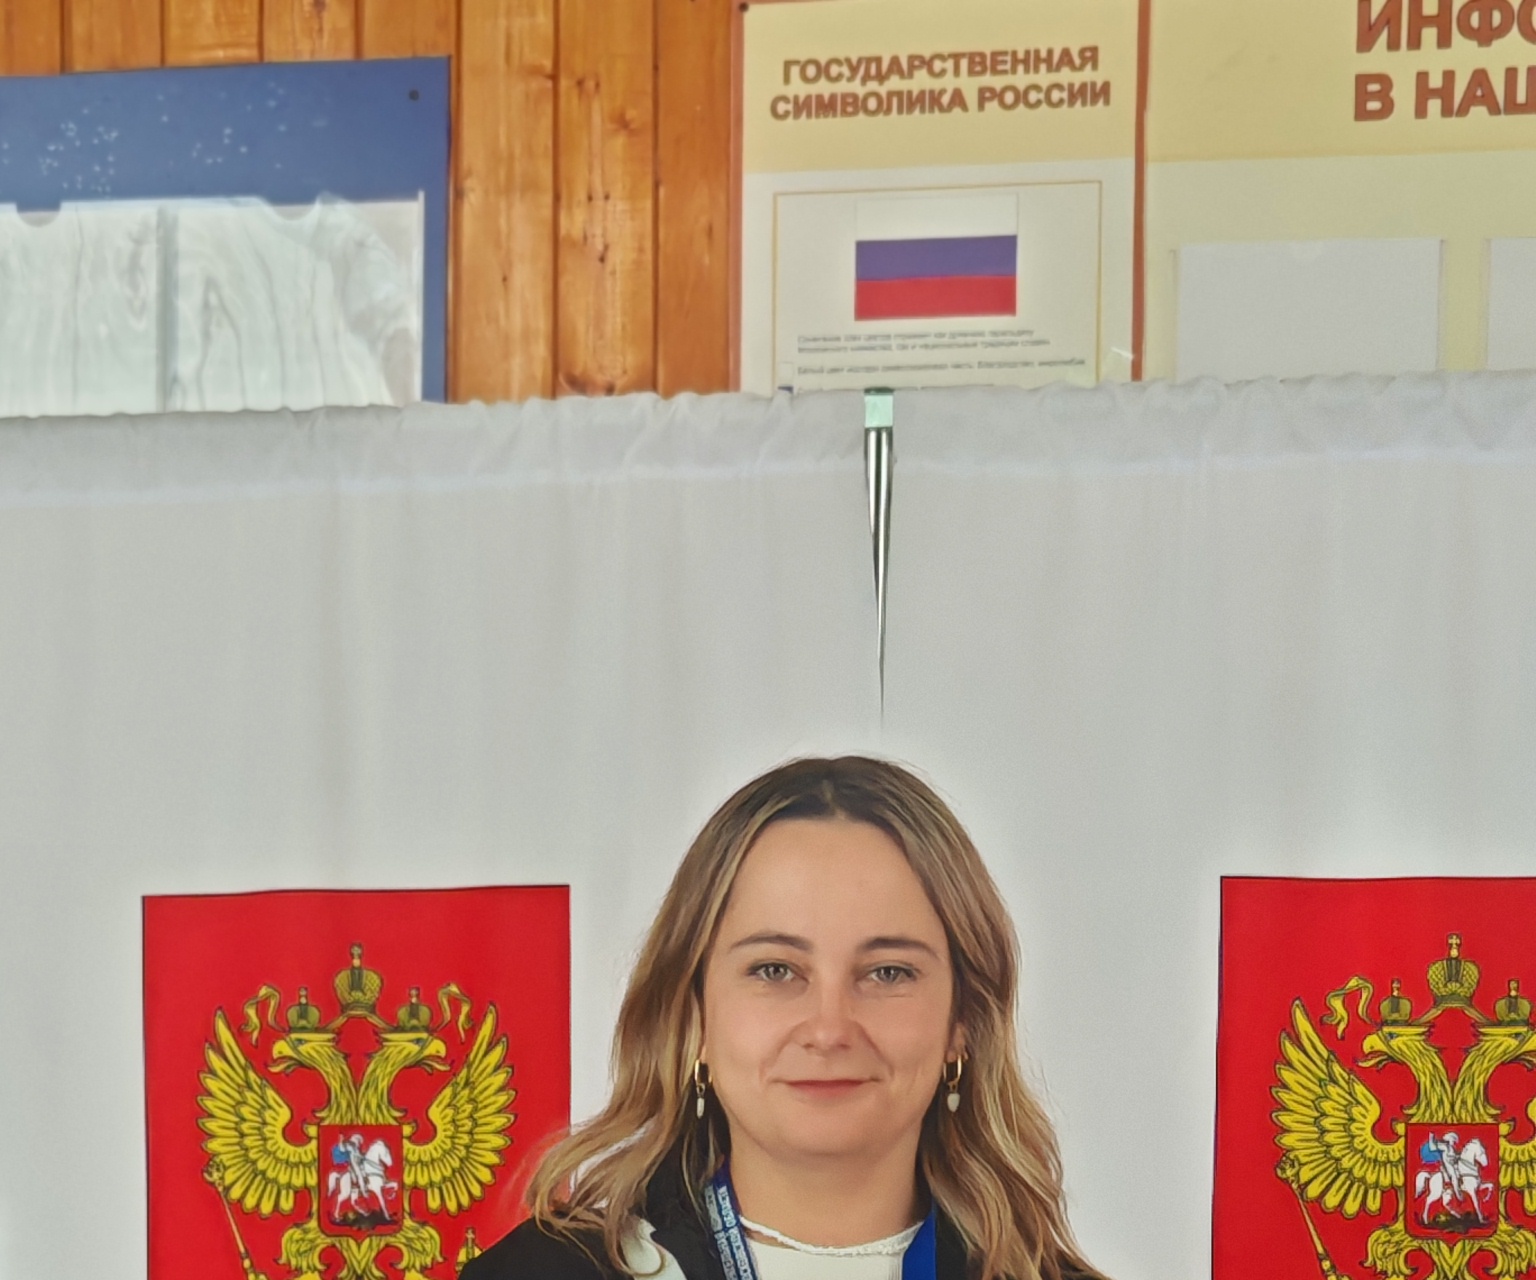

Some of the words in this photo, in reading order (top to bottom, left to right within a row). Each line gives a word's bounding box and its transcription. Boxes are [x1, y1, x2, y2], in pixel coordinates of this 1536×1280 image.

[783, 45, 1100, 86] ГОСУДАРСТВЕННАЯ
[770, 87, 969, 121] СИМВОЛИКА
[977, 80, 1111, 112] РОССИИ
[1354, 73, 1395, 122] В
